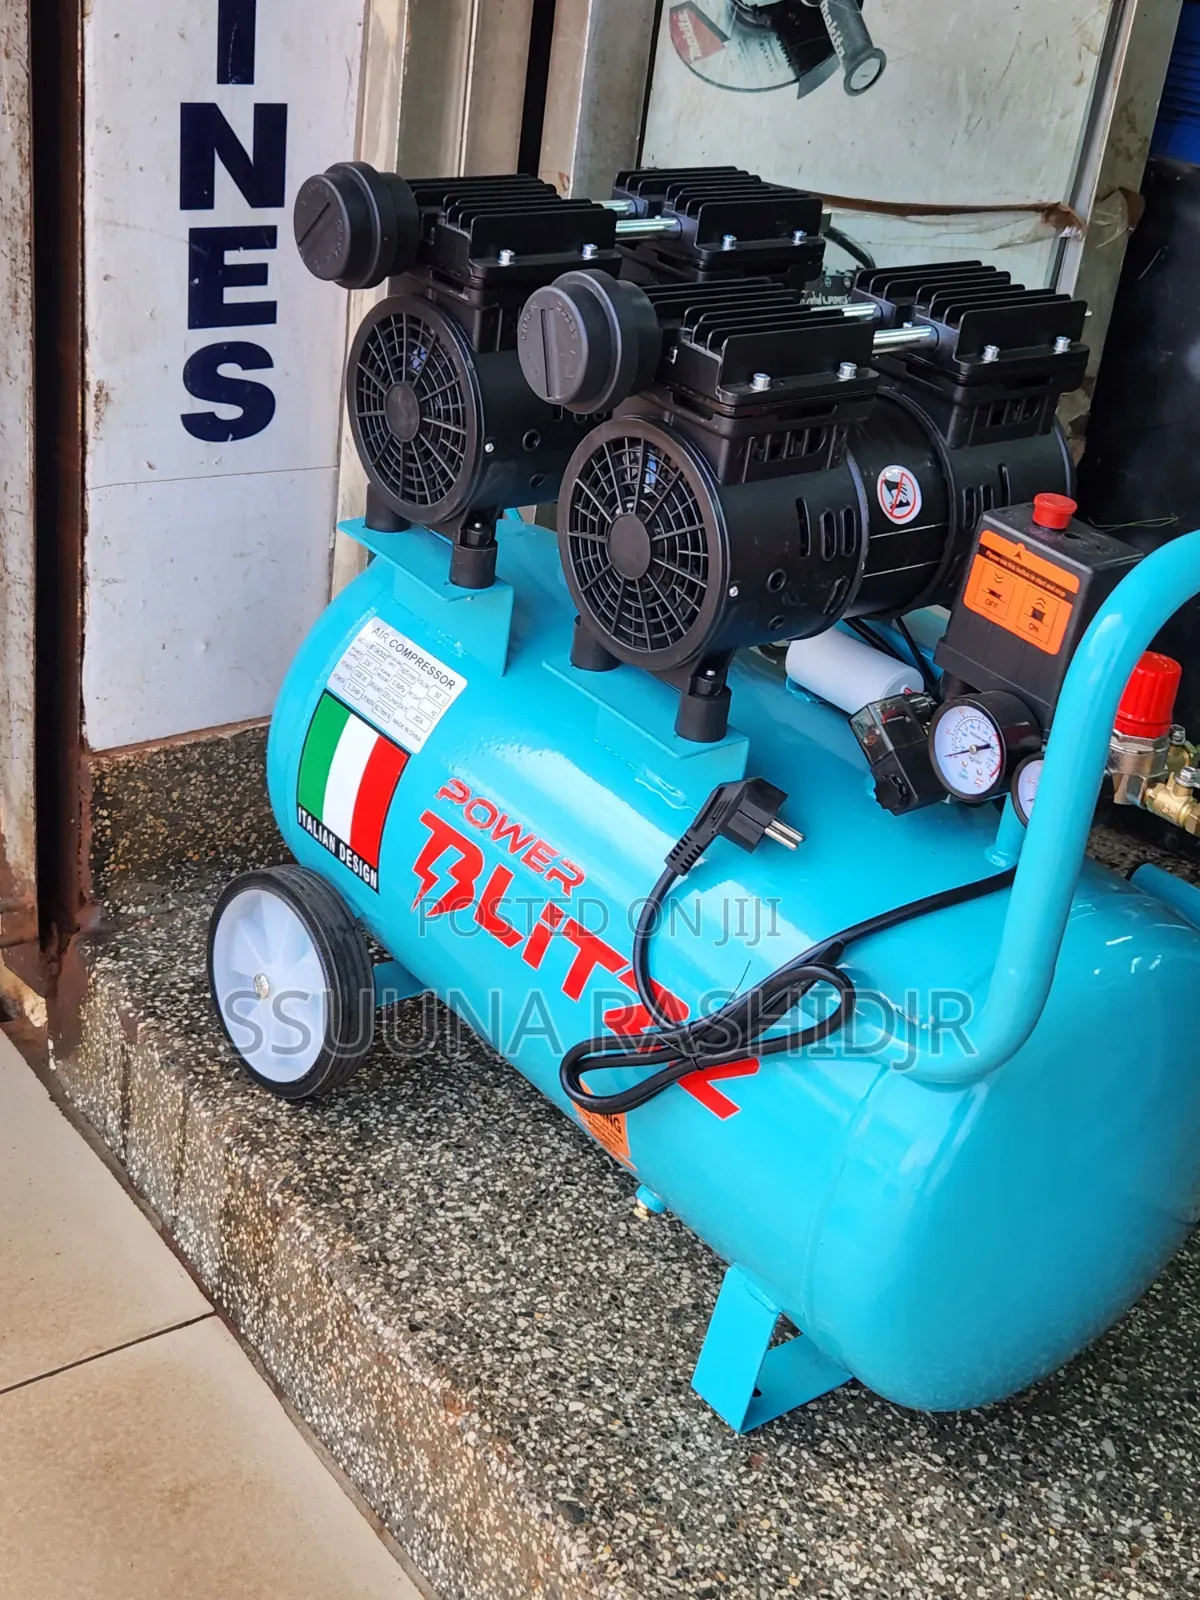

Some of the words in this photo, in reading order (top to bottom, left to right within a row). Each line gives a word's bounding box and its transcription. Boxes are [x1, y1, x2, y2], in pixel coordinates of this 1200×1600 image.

[984, 598, 998, 609] OFF
[1028, 622, 1039, 633] ON
[371, 627, 389, 643] AIR
[389, 639, 456, 691] COMPRESSOR
[298, 806, 336, 854] ITALIAN
[338, 842, 378, 890] DESIGN
[435, 778, 587, 898] POWER
